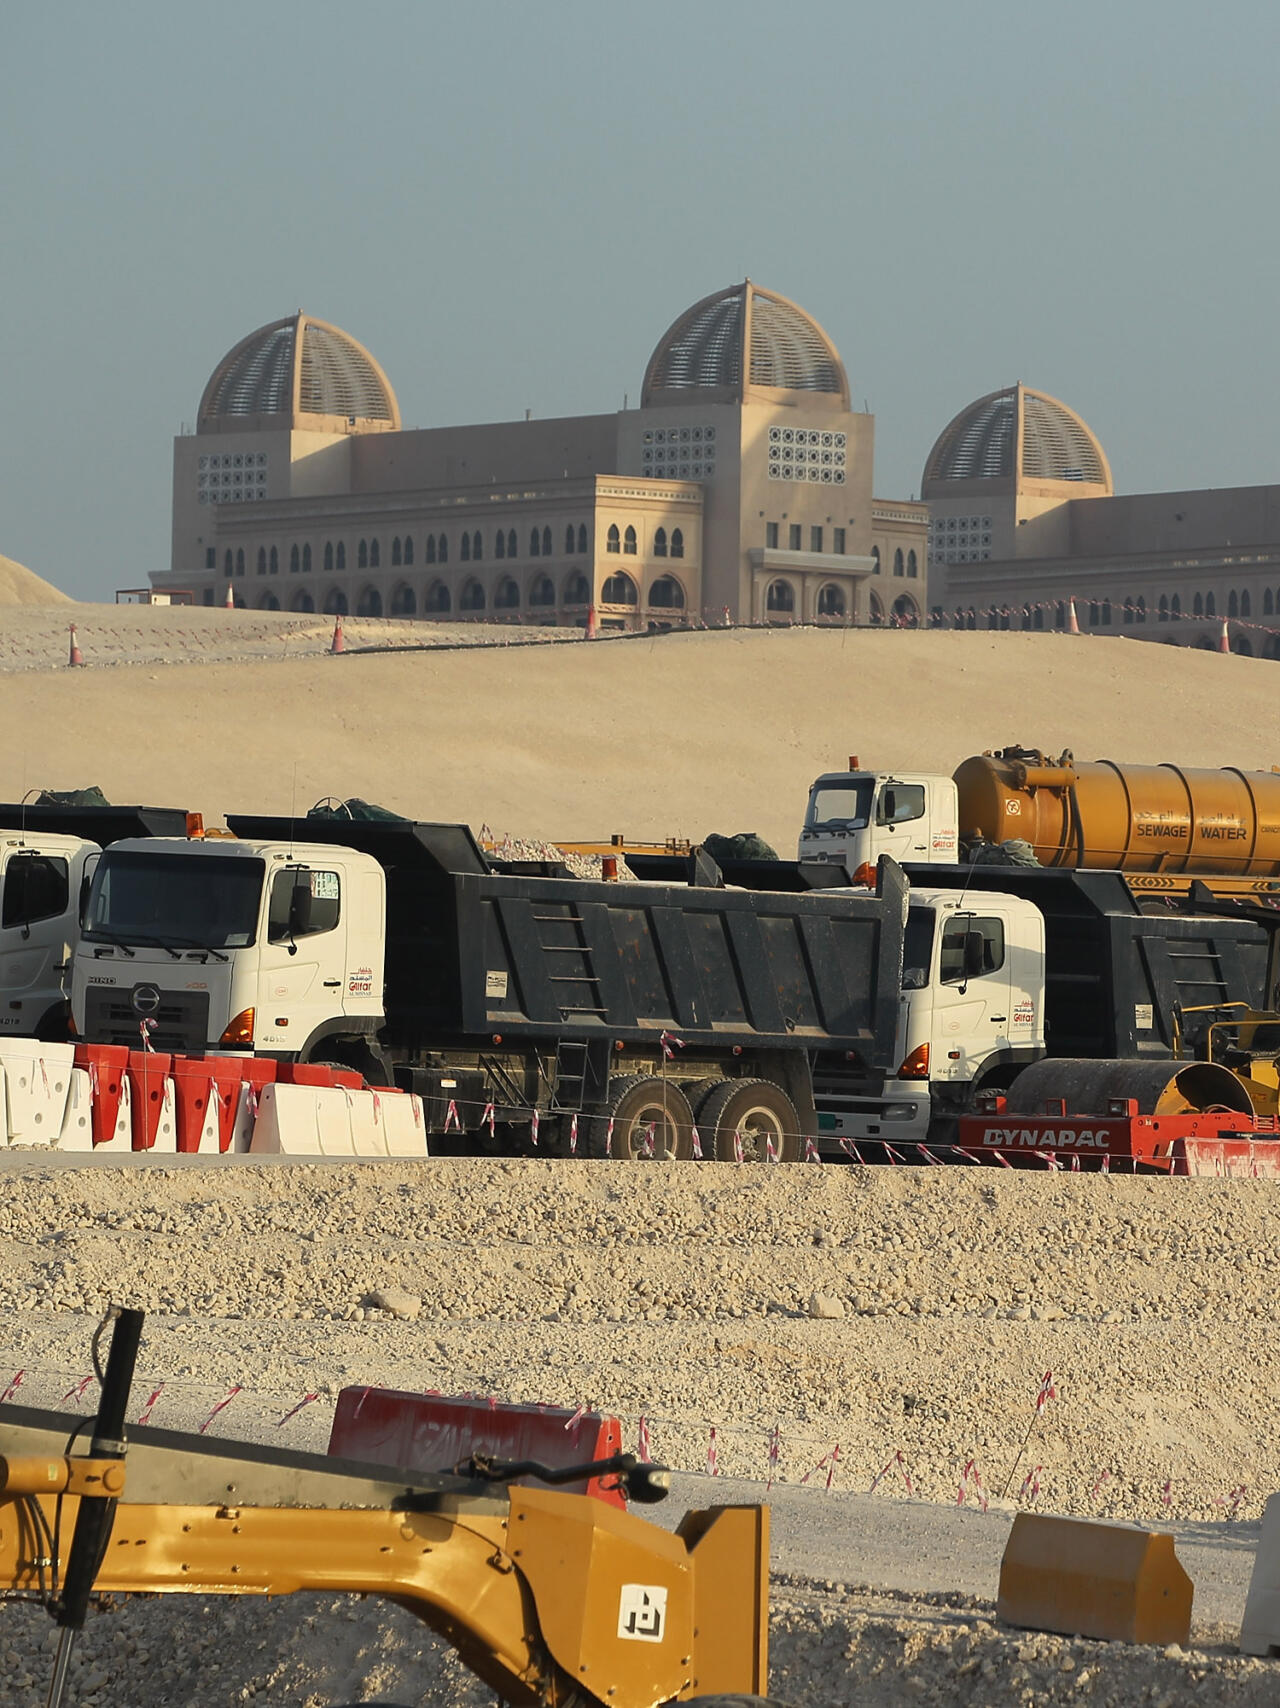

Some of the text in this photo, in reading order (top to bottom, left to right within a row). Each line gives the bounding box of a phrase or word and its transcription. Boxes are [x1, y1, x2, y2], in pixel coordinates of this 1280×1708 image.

[1137, 824, 1247, 840] SEWAGE WATER
[88, 976, 116, 984] HINO
[983, 1128, 1110, 1148] DYNAPAC
